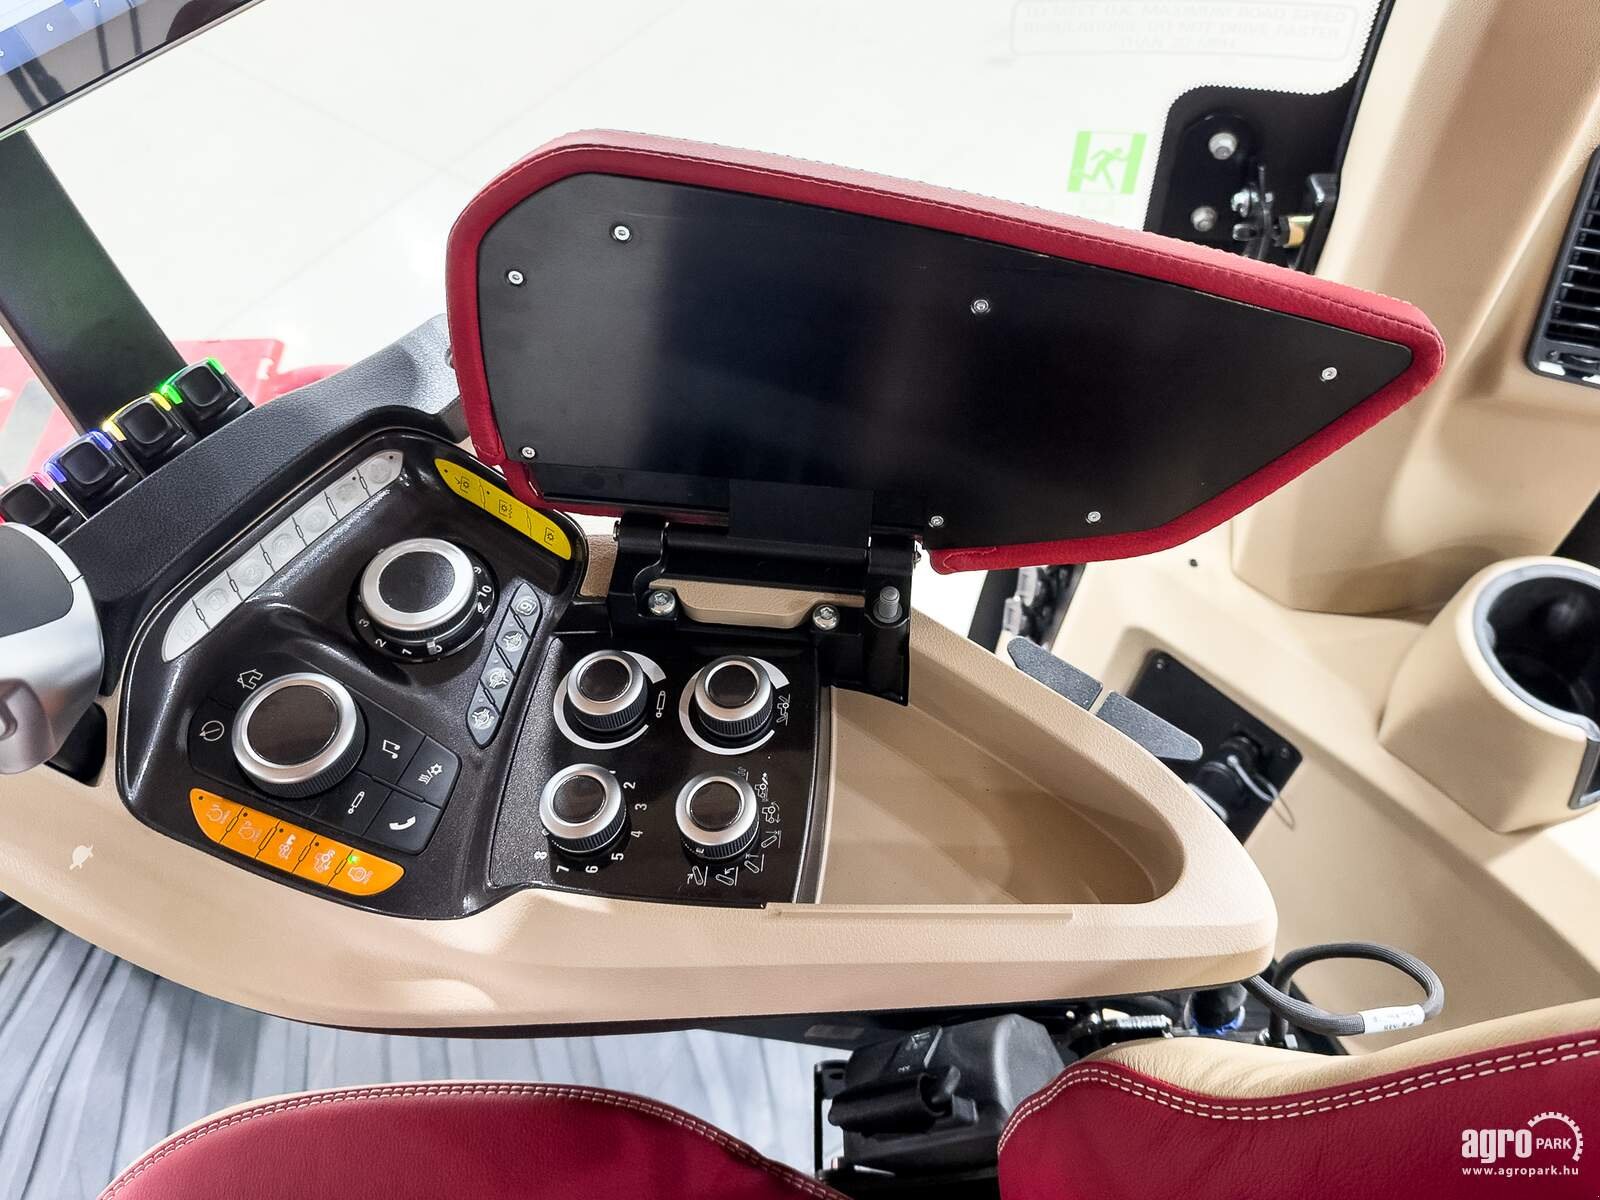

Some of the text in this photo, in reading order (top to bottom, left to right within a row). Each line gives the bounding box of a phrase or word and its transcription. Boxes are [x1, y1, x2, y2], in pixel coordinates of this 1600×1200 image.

[46, 23, 54, 32] 6
[476, 585, 492, 597] 10
[358, 618, 370, 628] 3
[375, 638, 387, 648] 2
[533, 781, 648, 873] 2 3 4 5 6 7 8
